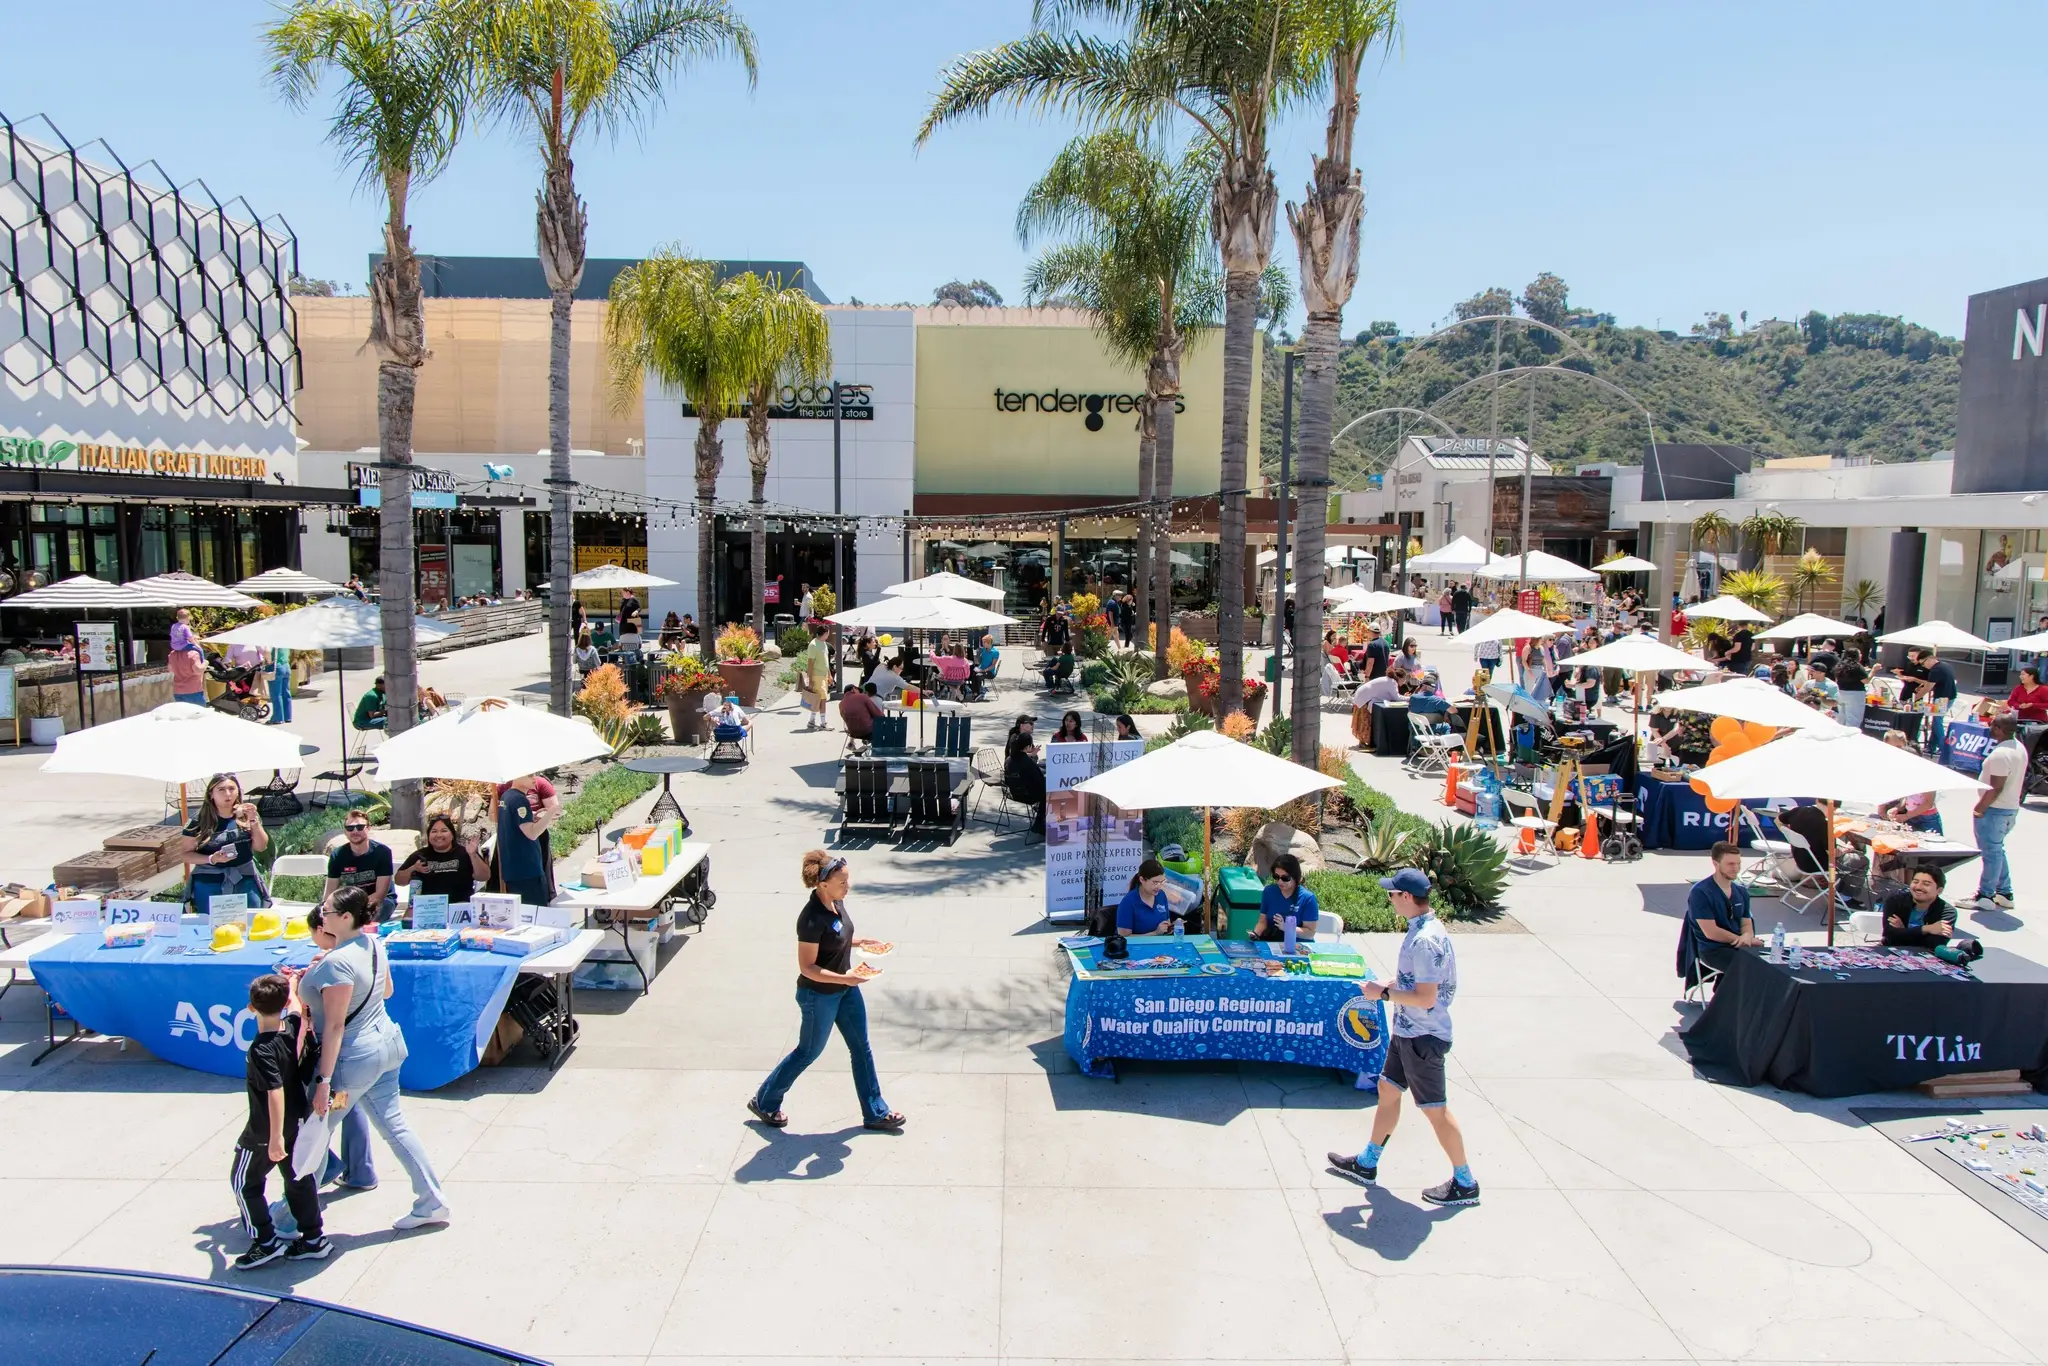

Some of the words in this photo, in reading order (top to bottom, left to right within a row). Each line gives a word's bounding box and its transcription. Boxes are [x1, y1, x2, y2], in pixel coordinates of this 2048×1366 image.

[2012, 303, 2048, 361] N
[816, 408, 844, 418] outlt
[845, 409, 868, 418] store
[79, 443, 149, 472] ITALIAN
[151, 450, 206, 475] CRAFT
[207, 454, 266, 478] KITCHEN
[1955, 732, 1998, 757] SHPE
[1050, 851, 1073, 862] YOUR
[1104, 847, 1142, 858] EXPERTS
[607, 866, 629, 881] PRIZES
[1103, 865, 1137, 873] SERVICES
[149, 913, 177, 923] ACEC
[1134, 997, 1165, 1014] San
[1168, 997, 1215, 1015] Diego
[1218, 997, 1291, 1015] Regional
[1100, 1017, 1149, 1035] Water
[1152, 1017, 1208, 1036] Quality
[1211, 1016, 1273, 1034] Control
[1275, 1018, 1324, 1037] Board
[1886, 1034, 1981, 1062] TYLin
